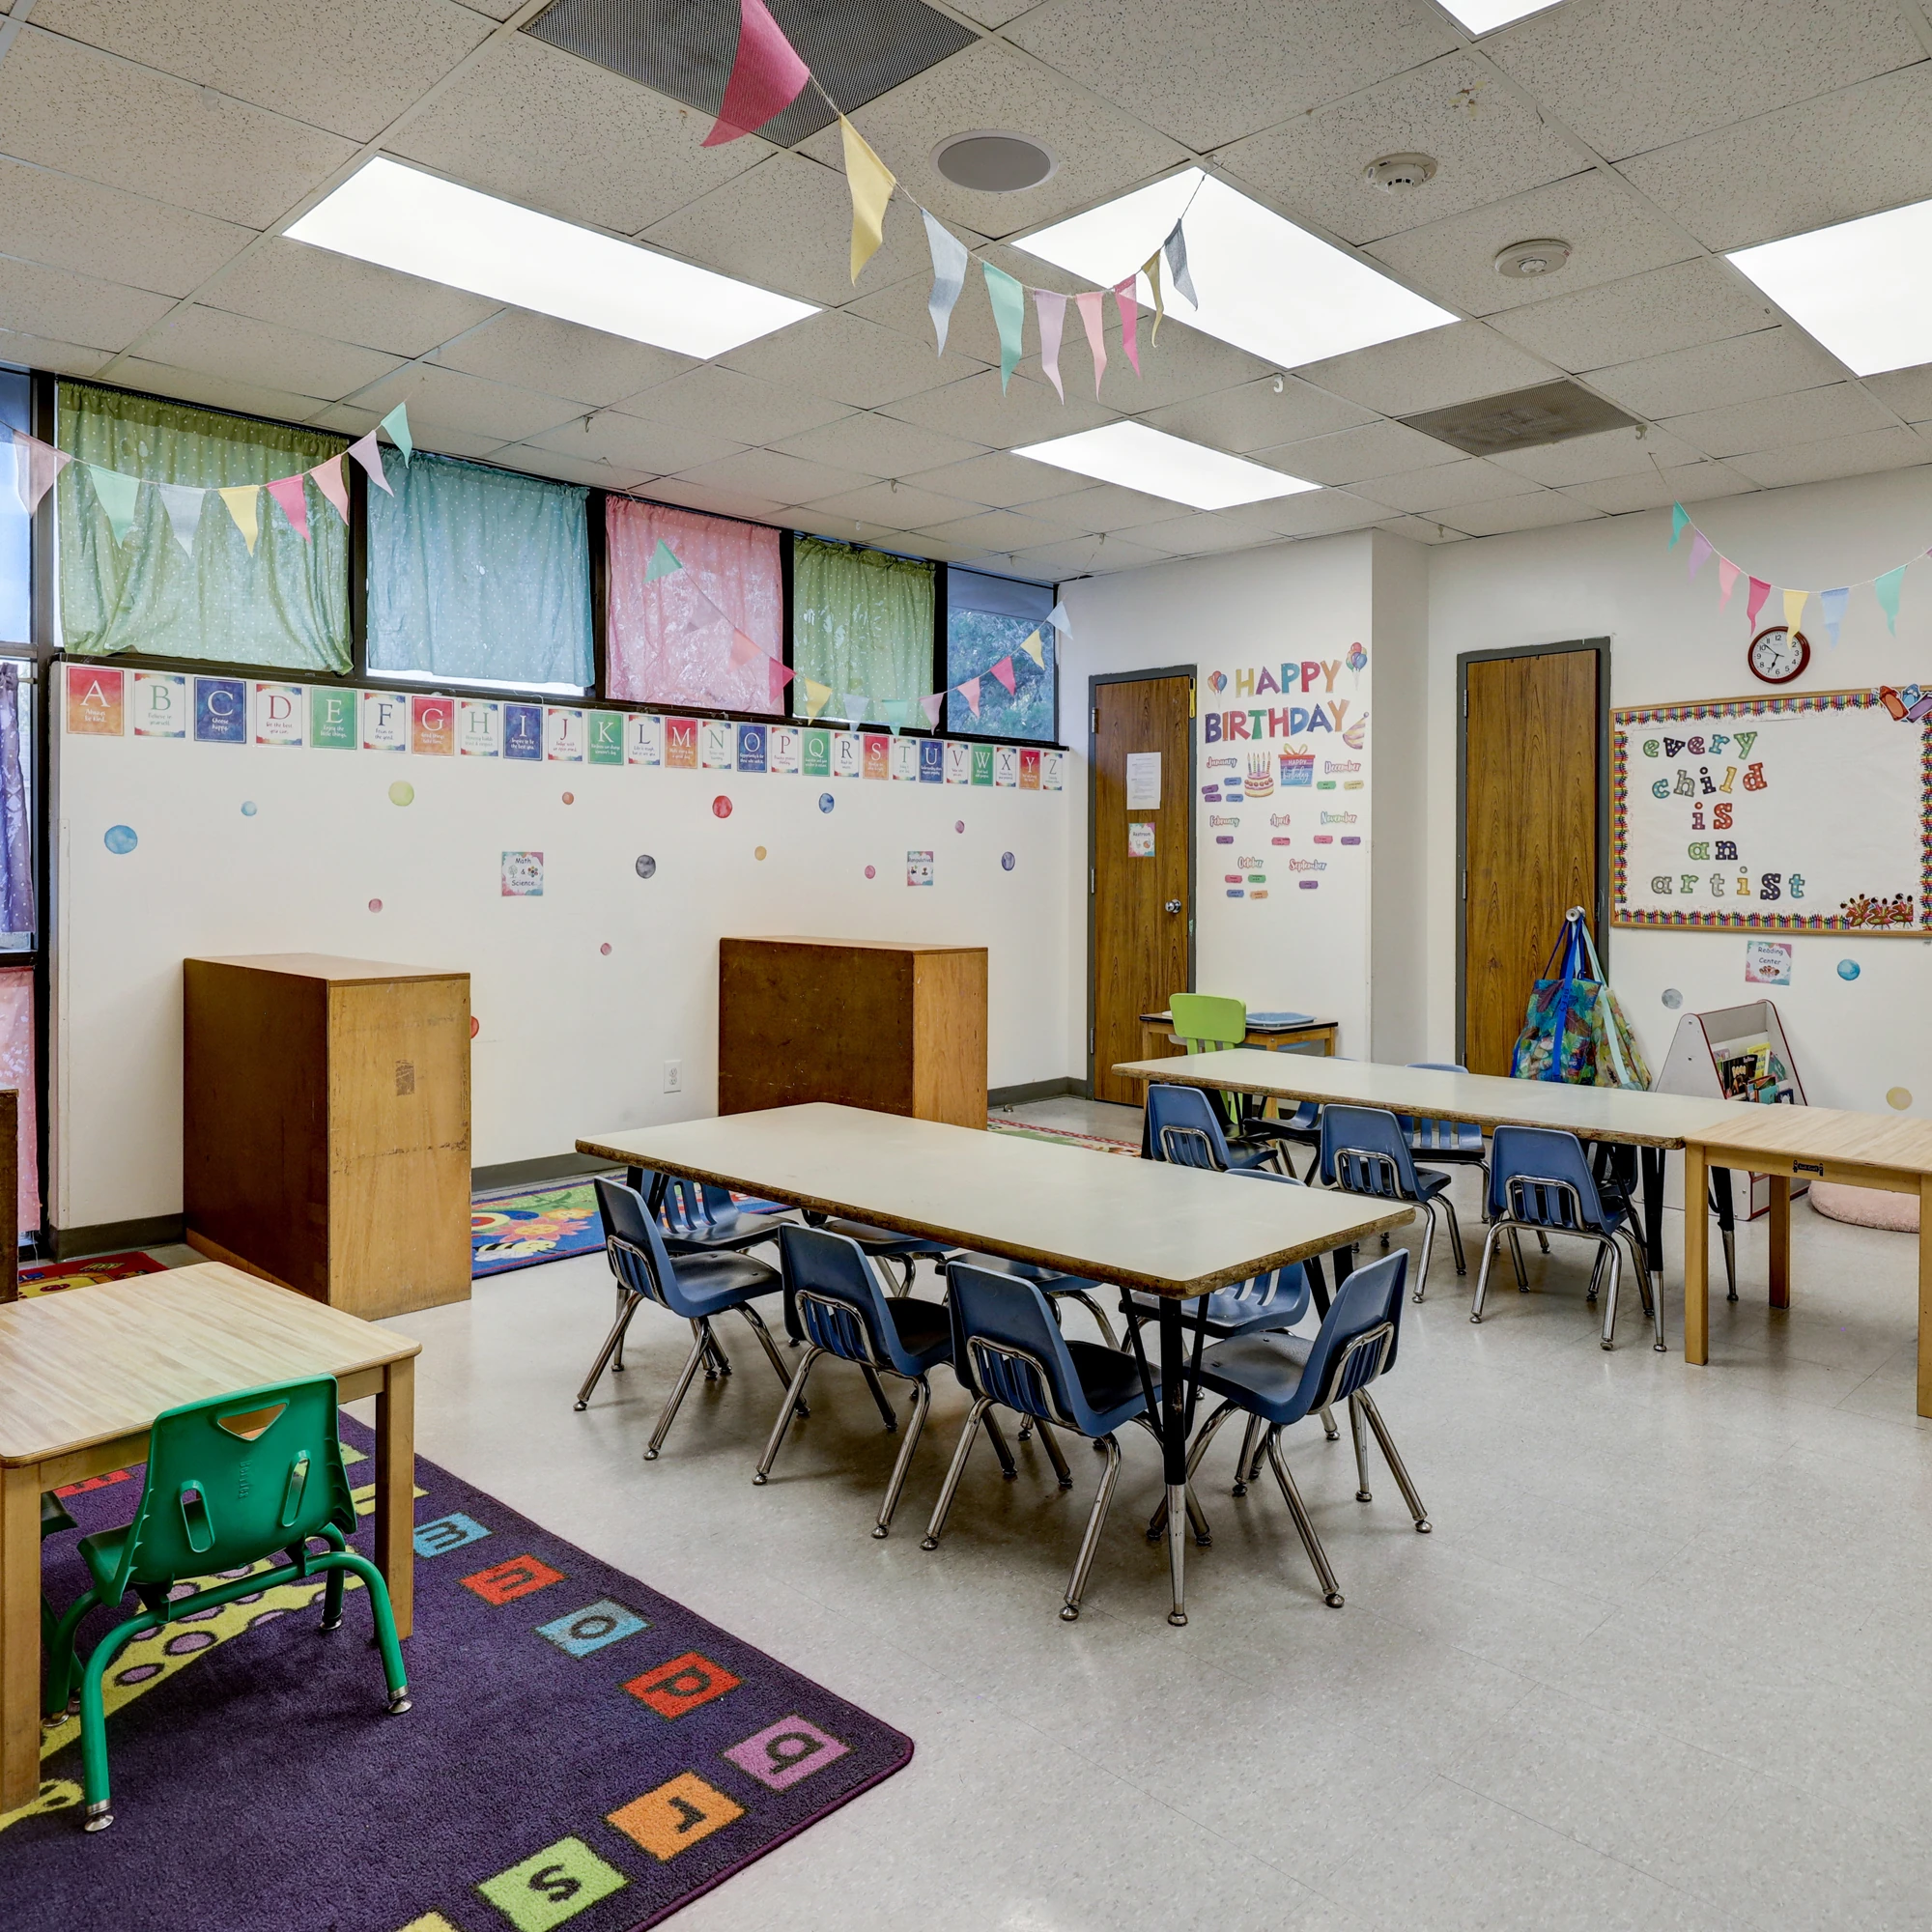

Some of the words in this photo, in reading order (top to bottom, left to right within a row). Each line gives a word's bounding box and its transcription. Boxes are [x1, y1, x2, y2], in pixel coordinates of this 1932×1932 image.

[1236, 660, 1342, 697] HAPPY
[80, 680, 111, 707] A
[151, 685, 171, 711] B
[208, 690, 234, 716] C
[268, 695, 292, 720] D
[326, 698, 343, 724] E
[378, 702, 393, 726] F
[421, 707, 444, 731] G
[469, 711, 490, 734] H
[519, 714, 527, 737] I
[560, 718, 569, 741] J
[1205, 699, 1350, 744] BIRTHDAY
[597, 722, 614, 744] K
[639, 724, 651, 744] L
[671, 726, 691, 748] M
[708, 729, 724, 750] N
[744, 732, 760, 753] O
[780, 735, 791, 754] P
[809, 738, 824, 758] Q
[841, 740, 853, 759] R
[871, 743, 881, 761] S
[899, 746, 911, 763] T
[1642, 731, 1758, 760] every
[924, 747, 938, 765] U
[952, 750, 963, 766] V
[975, 751, 991, 769] W
[1002, 753, 1011, 771] X
[1025, 756, 1035, 773] Y
[1049, 758, 1057, 775] Z
[1207, 756, 1237, 769] January
[1324, 759, 1361, 775] December
[1652, 762, 1768, 799] child
[1209, 814, 1240, 828] February
[1270, 813, 1291, 828] April
[1321, 810, 1357, 825] November
[1688, 840, 1738, 861] an
[1237, 856, 1264, 869] October
[1289, 858, 1327, 873] September
[1758, 946, 1783, 956] Reading
[414, 1521, 468, 1550] m
[487, 1567, 537, 1592] n
[571, 1615, 616, 1639] o
[644, 1664, 712, 1697] p
[765, 1732, 826, 1776] q
[668, 1795, 708, 1833] r
[527, 1864, 582, 1903] s
